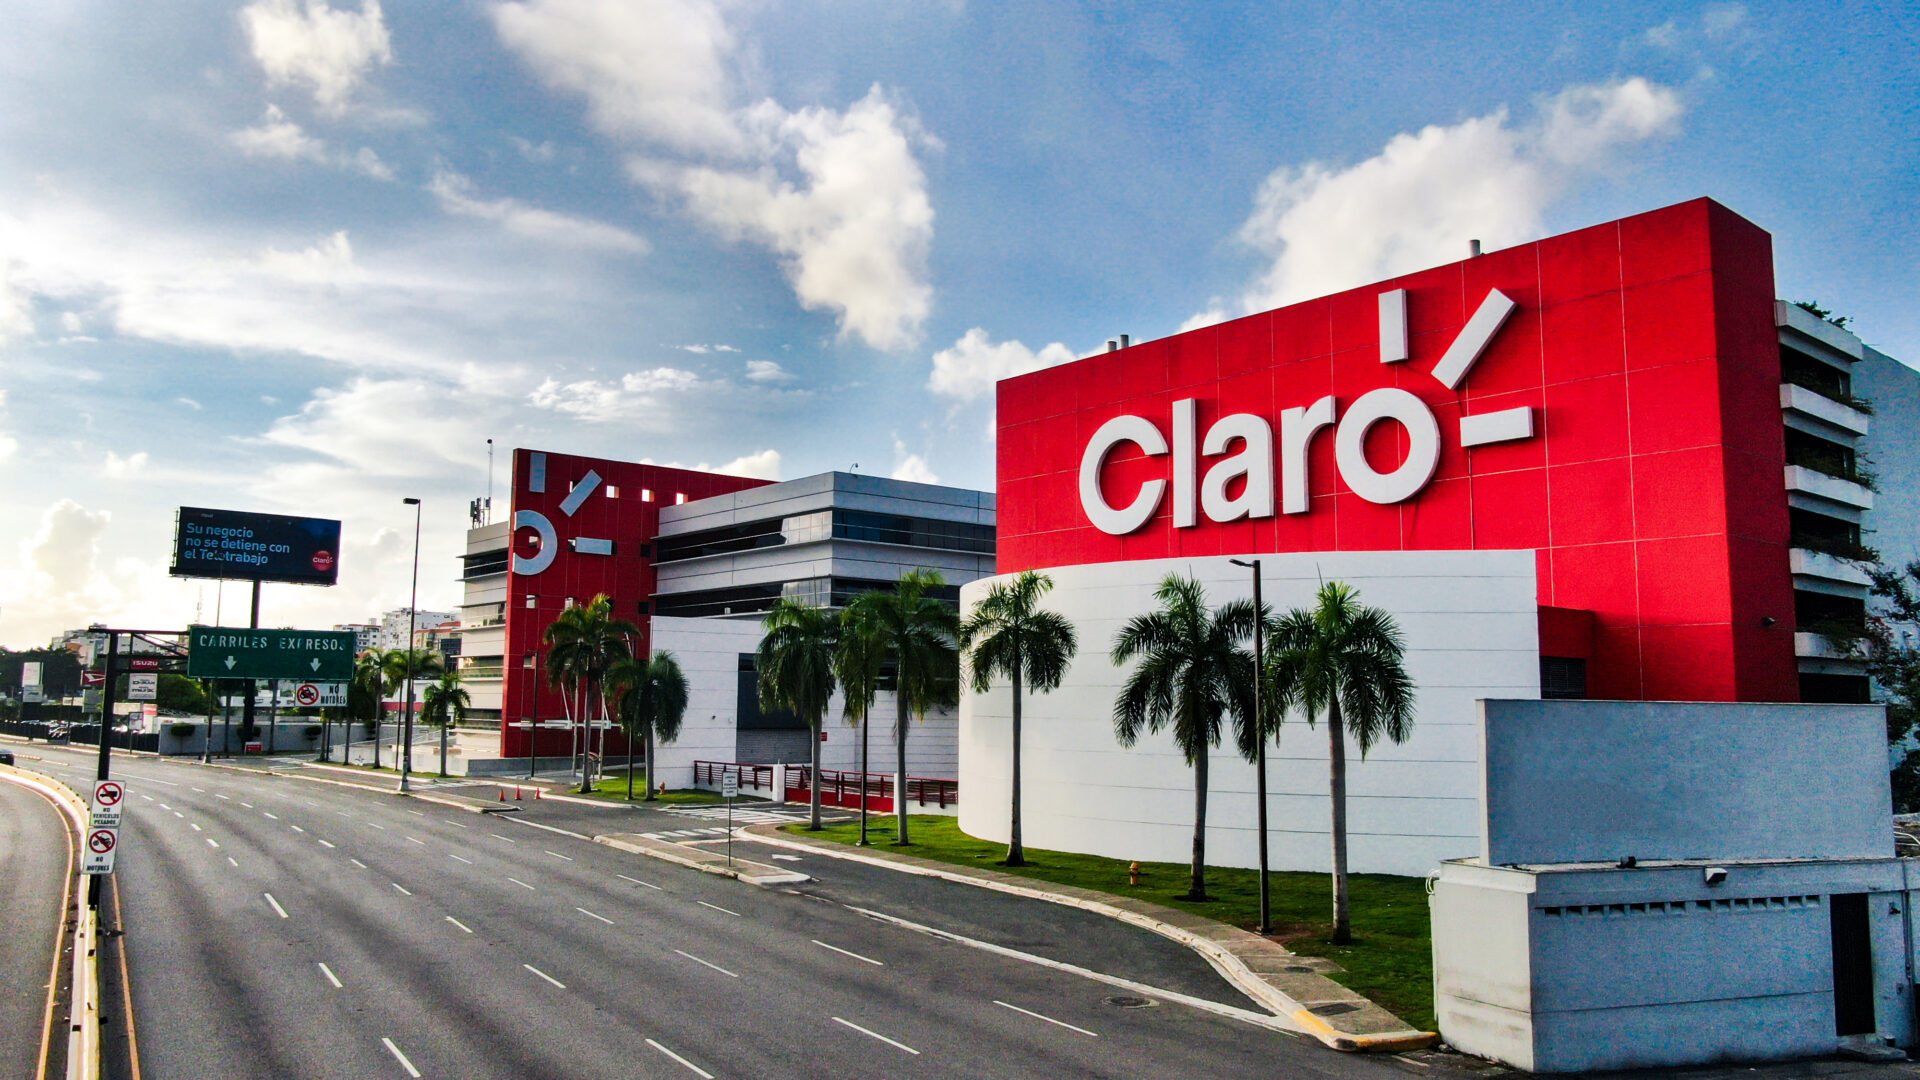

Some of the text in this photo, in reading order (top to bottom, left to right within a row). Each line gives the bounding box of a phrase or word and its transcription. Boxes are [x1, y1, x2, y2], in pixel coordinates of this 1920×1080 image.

[187, 522, 254, 538] Su negocio
[185, 537, 290, 553] no se detiene con
[184, 548, 196, 559] el
[200, 635, 268, 649] CARRILES
[329, 685, 339, 694] NO
